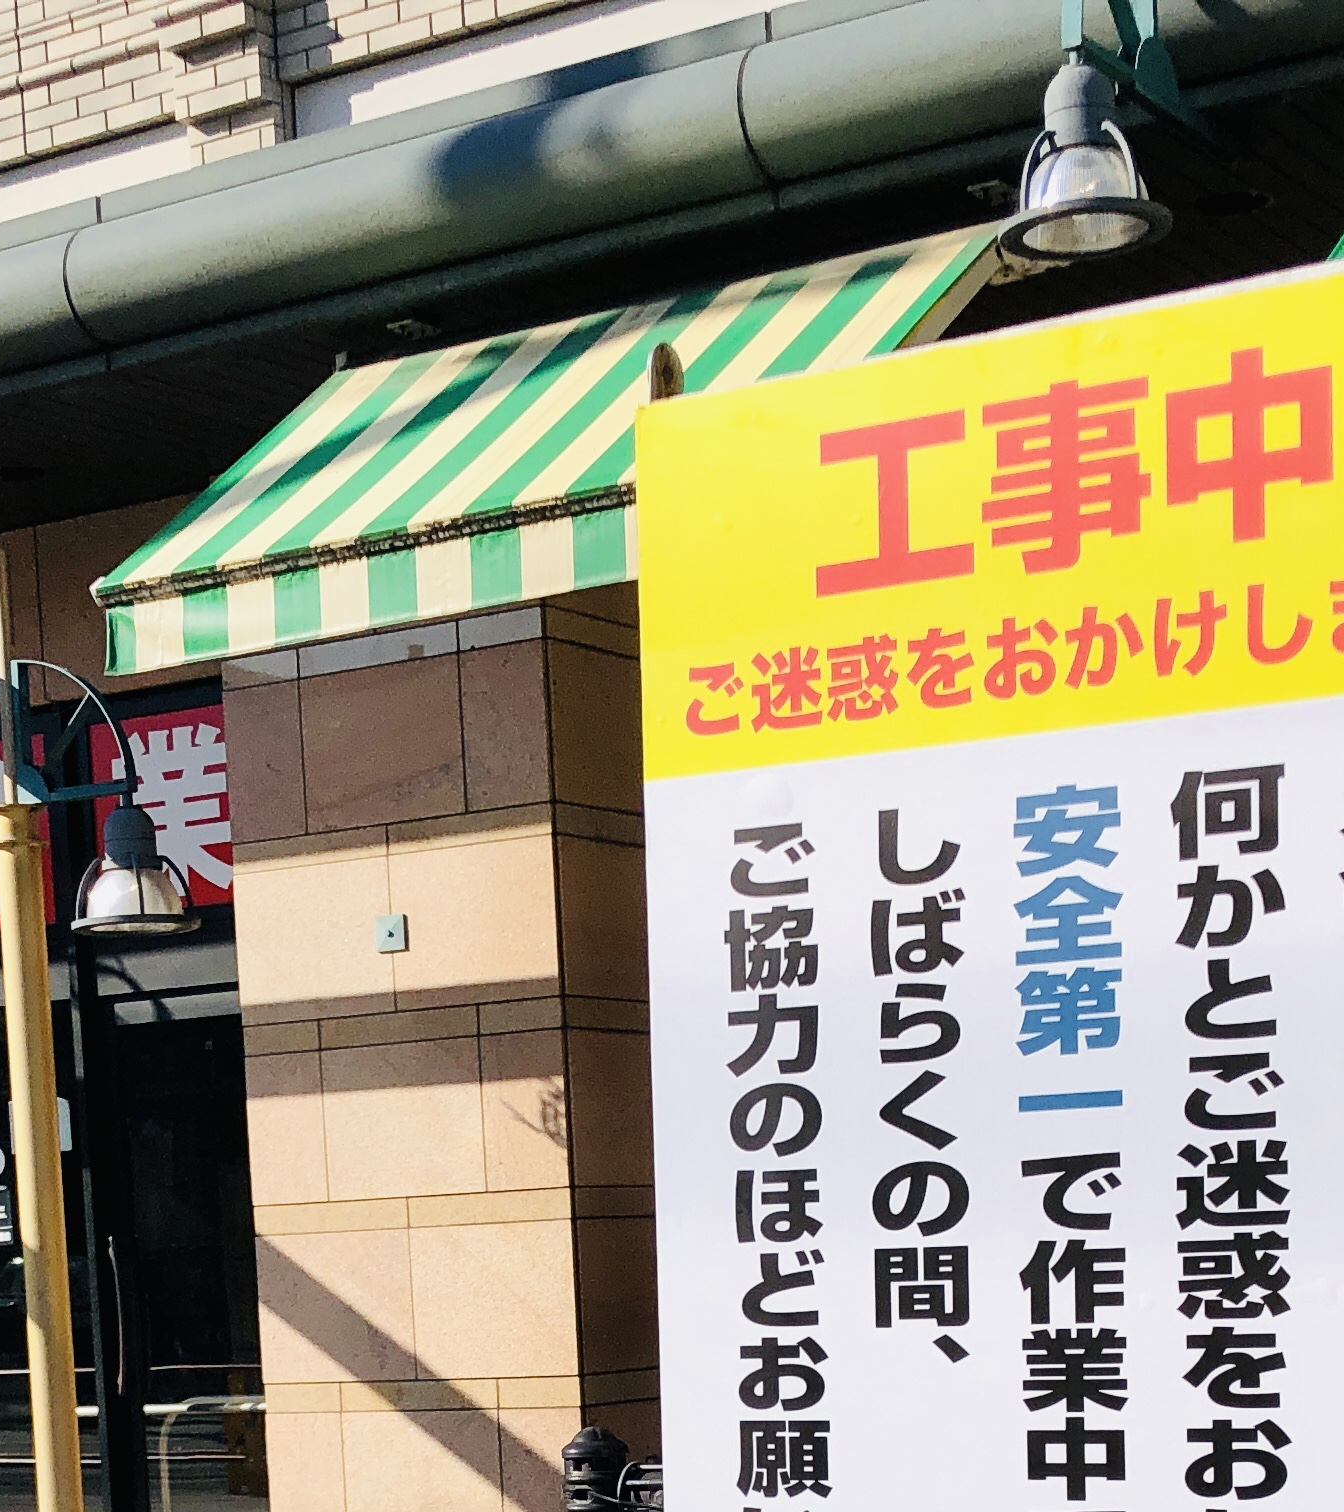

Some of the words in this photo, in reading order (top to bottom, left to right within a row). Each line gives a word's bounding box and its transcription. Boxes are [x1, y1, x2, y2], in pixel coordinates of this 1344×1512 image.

[814, 346, 1335, 599] 工事中
[869, 808, 972, 1364] しばらくの間、
